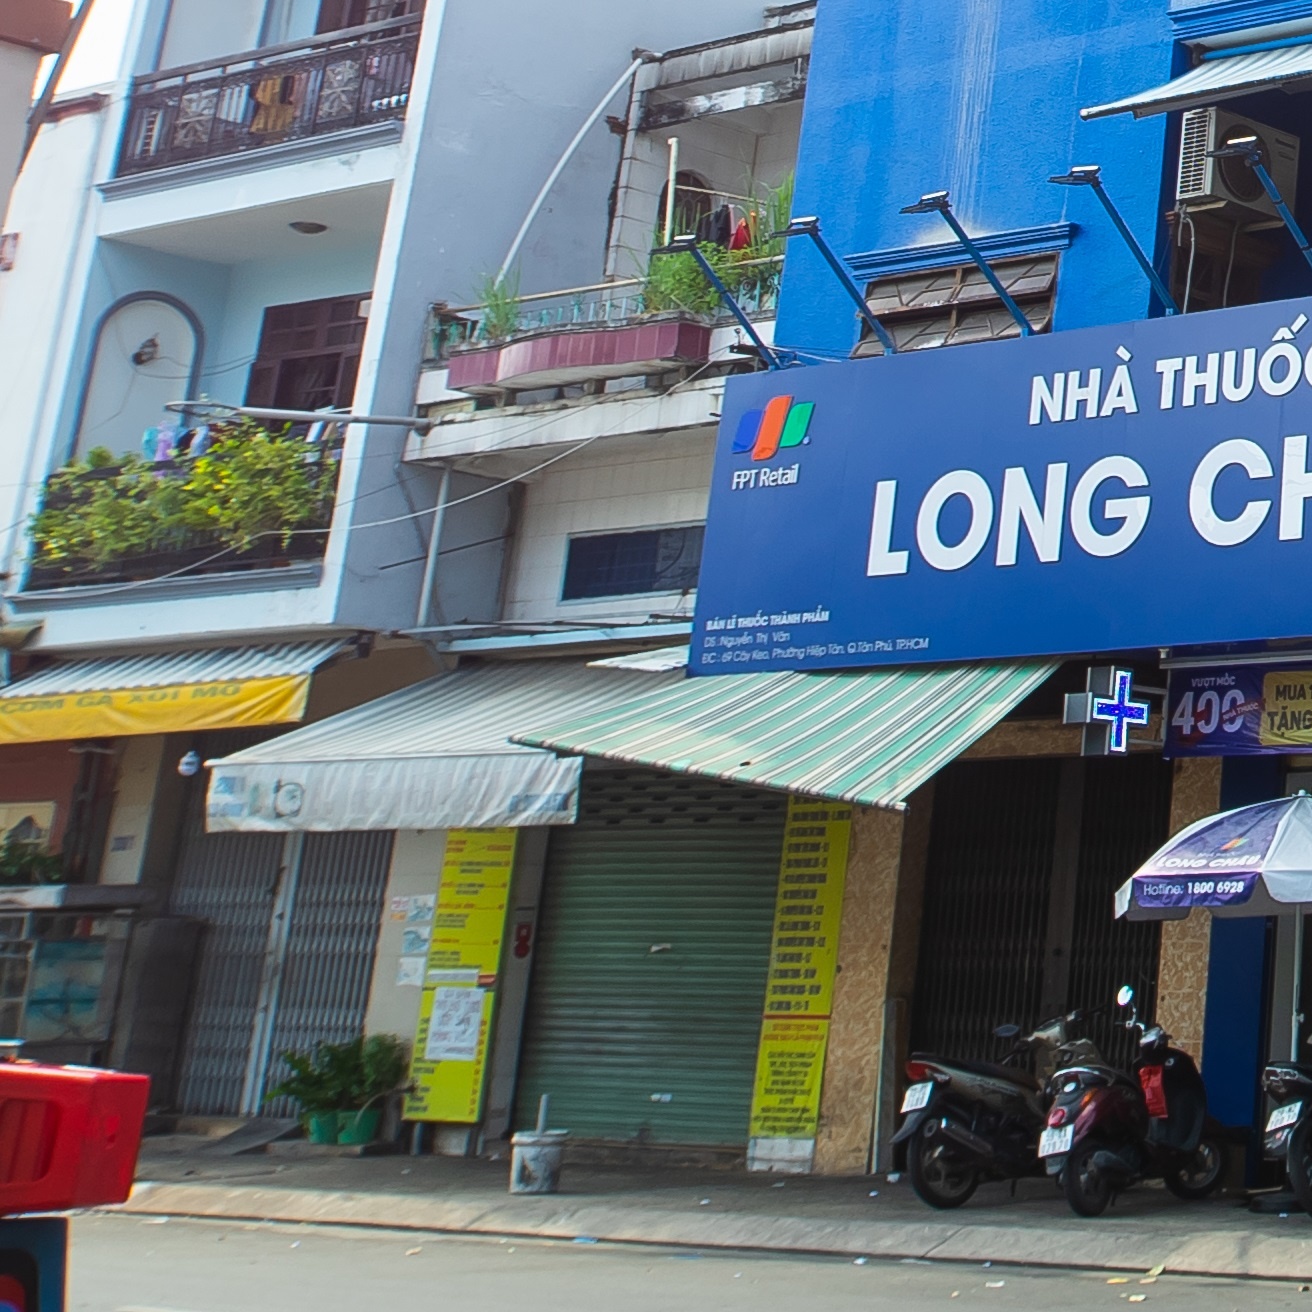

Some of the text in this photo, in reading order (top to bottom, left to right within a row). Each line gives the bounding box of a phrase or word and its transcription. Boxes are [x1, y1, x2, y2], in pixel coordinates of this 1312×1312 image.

[1028, 345, 1139, 426] NHÀ
[731, 463, 800, 491] FPT Retail
[867, 455, 1152, 577] LONG
[1191, 676, 1216, 688] VƯỢT
[1275, 684, 1306, 701] MUA
[1187, 881, 1215, 895] 1800
[1216, 880, 1245, 894] 6928
